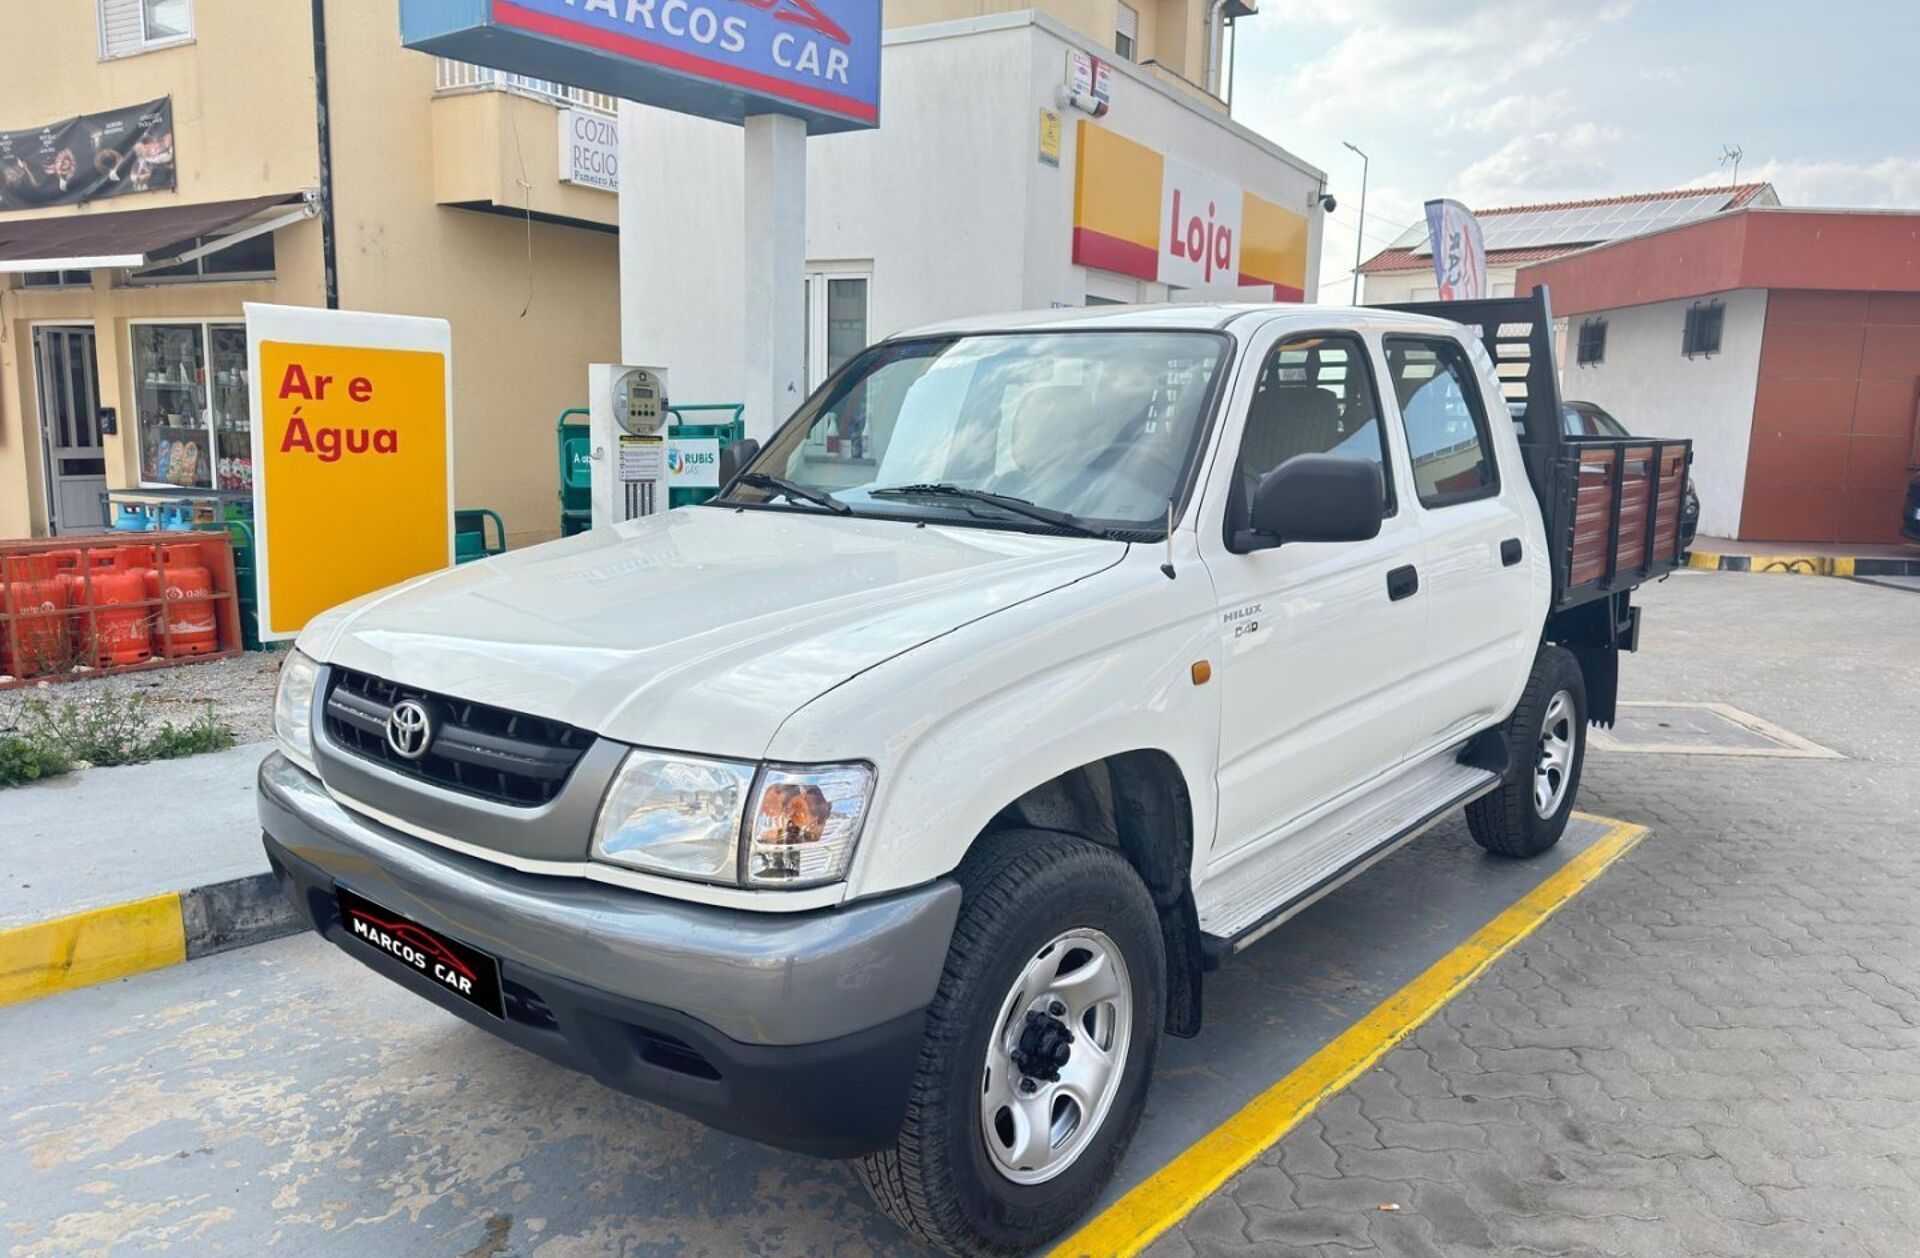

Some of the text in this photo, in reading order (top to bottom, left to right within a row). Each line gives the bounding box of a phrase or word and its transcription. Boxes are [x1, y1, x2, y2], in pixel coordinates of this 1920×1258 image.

[565, 0, 850, 84] RCOS CAR
[574, 145, 618, 176] REGIO
[1170, 188, 1232, 283] Loja
[279, 363, 372, 403] Ar e
[280, 406, 398, 463] Água
[1223, 604, 1262, 623] HILUX
[353, 917, 472, 995] MARCOS CAR
